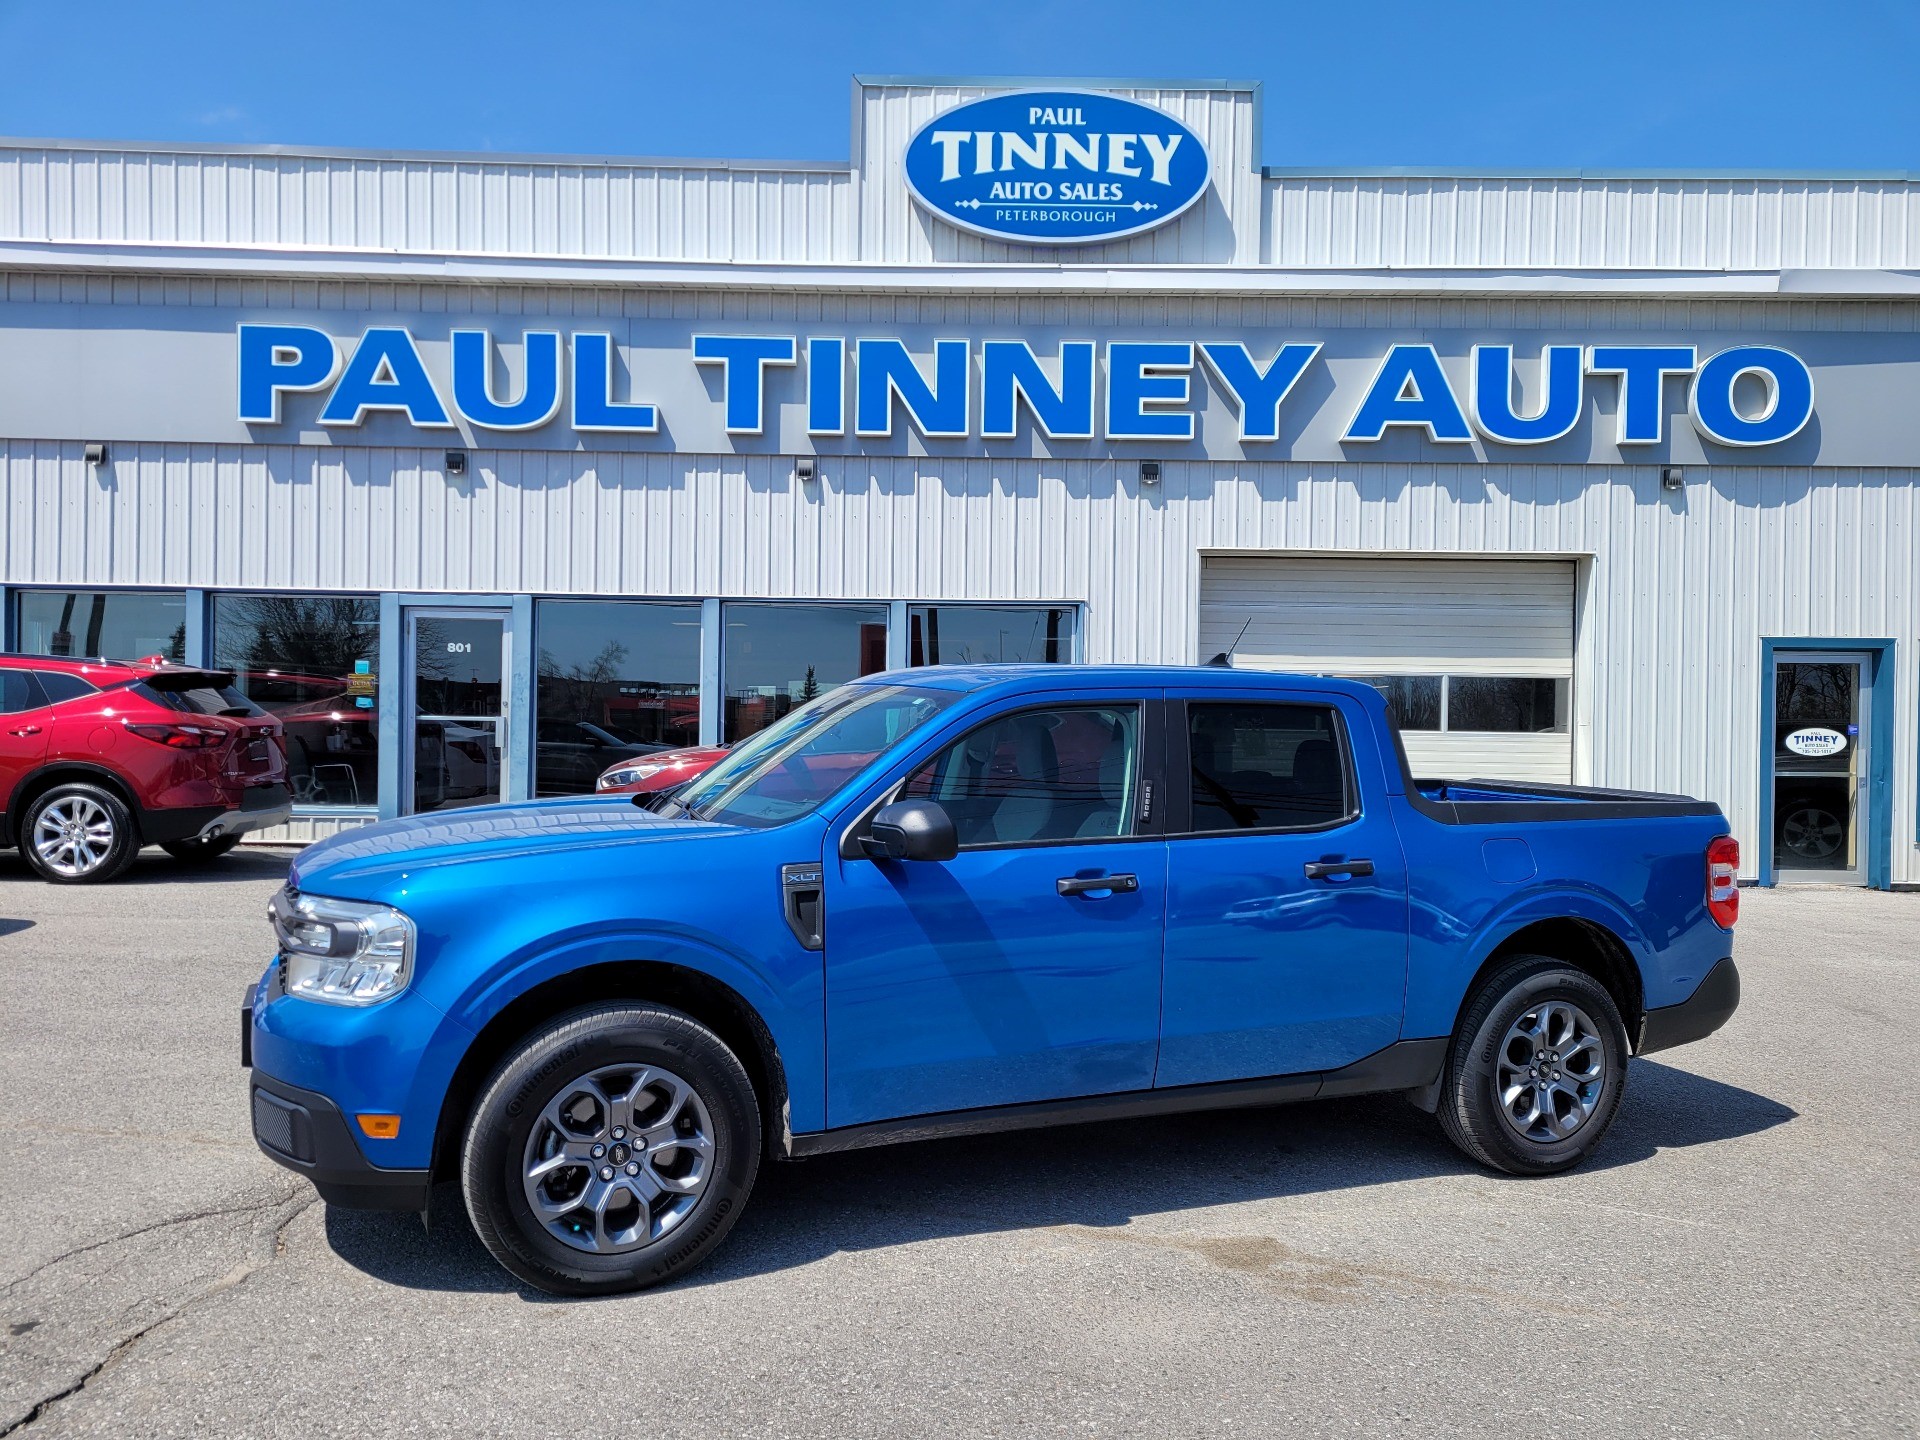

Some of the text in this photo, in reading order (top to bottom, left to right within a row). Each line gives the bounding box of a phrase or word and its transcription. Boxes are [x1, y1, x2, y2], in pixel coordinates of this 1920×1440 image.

[1028, 107, 1086, 125] PAUL
[931, 130, 1183, 186] TINNEY
[989, 182, 1123, 201] AUTO SALES
[996, 209, 1116, 223] PETERBOROUGH
[236, 322, 1815, 447] PAUL TINNEY AUTO
[447, 642, 472, 653] 801
[1794, 735, 1838, 745] TINNEY
[787, 873, 821, 883] XLT
